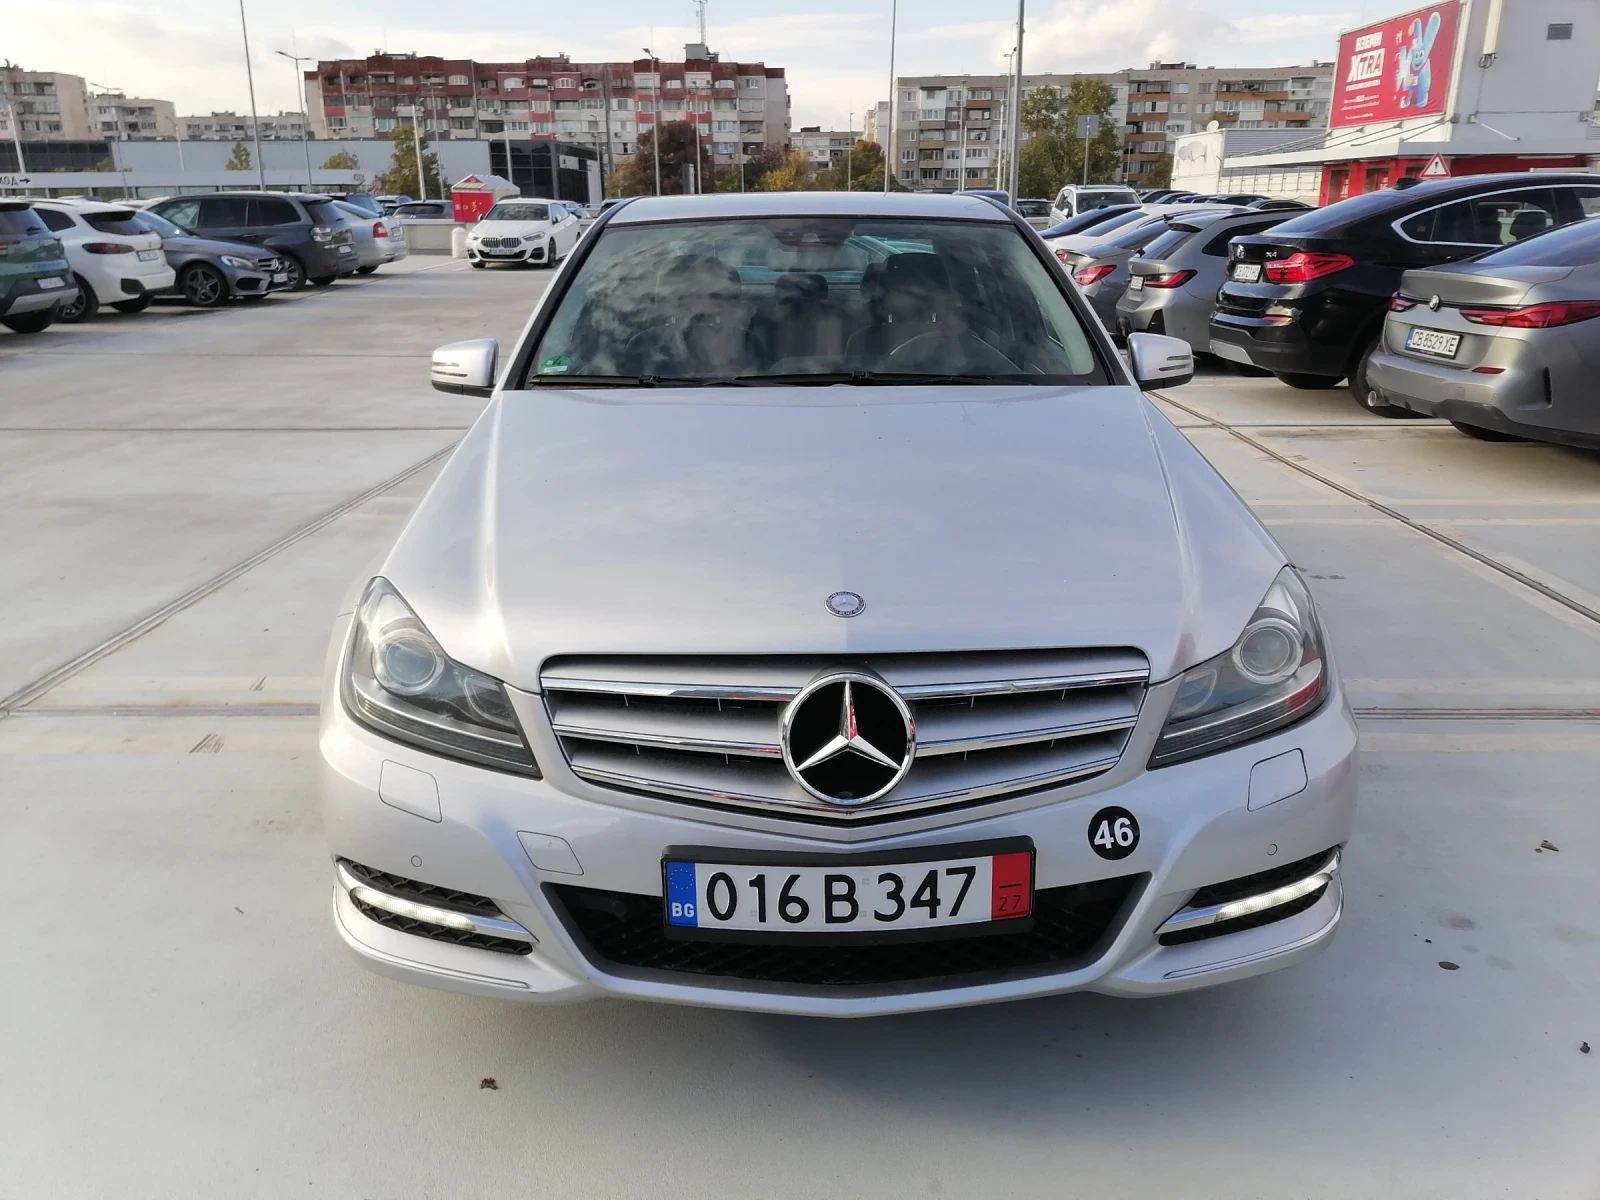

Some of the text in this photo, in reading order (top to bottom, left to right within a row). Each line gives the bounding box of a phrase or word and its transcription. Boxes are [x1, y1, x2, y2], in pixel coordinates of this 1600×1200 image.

[1347, 48, 1386, 83] XTRA
[1412, 331, 1457, 352] CB 8529 XE
[1094, 817, 1134, 849] 46
[672, 866, 977, 924] BG 016 B 347
[998, 894, 1022, 912] 27
